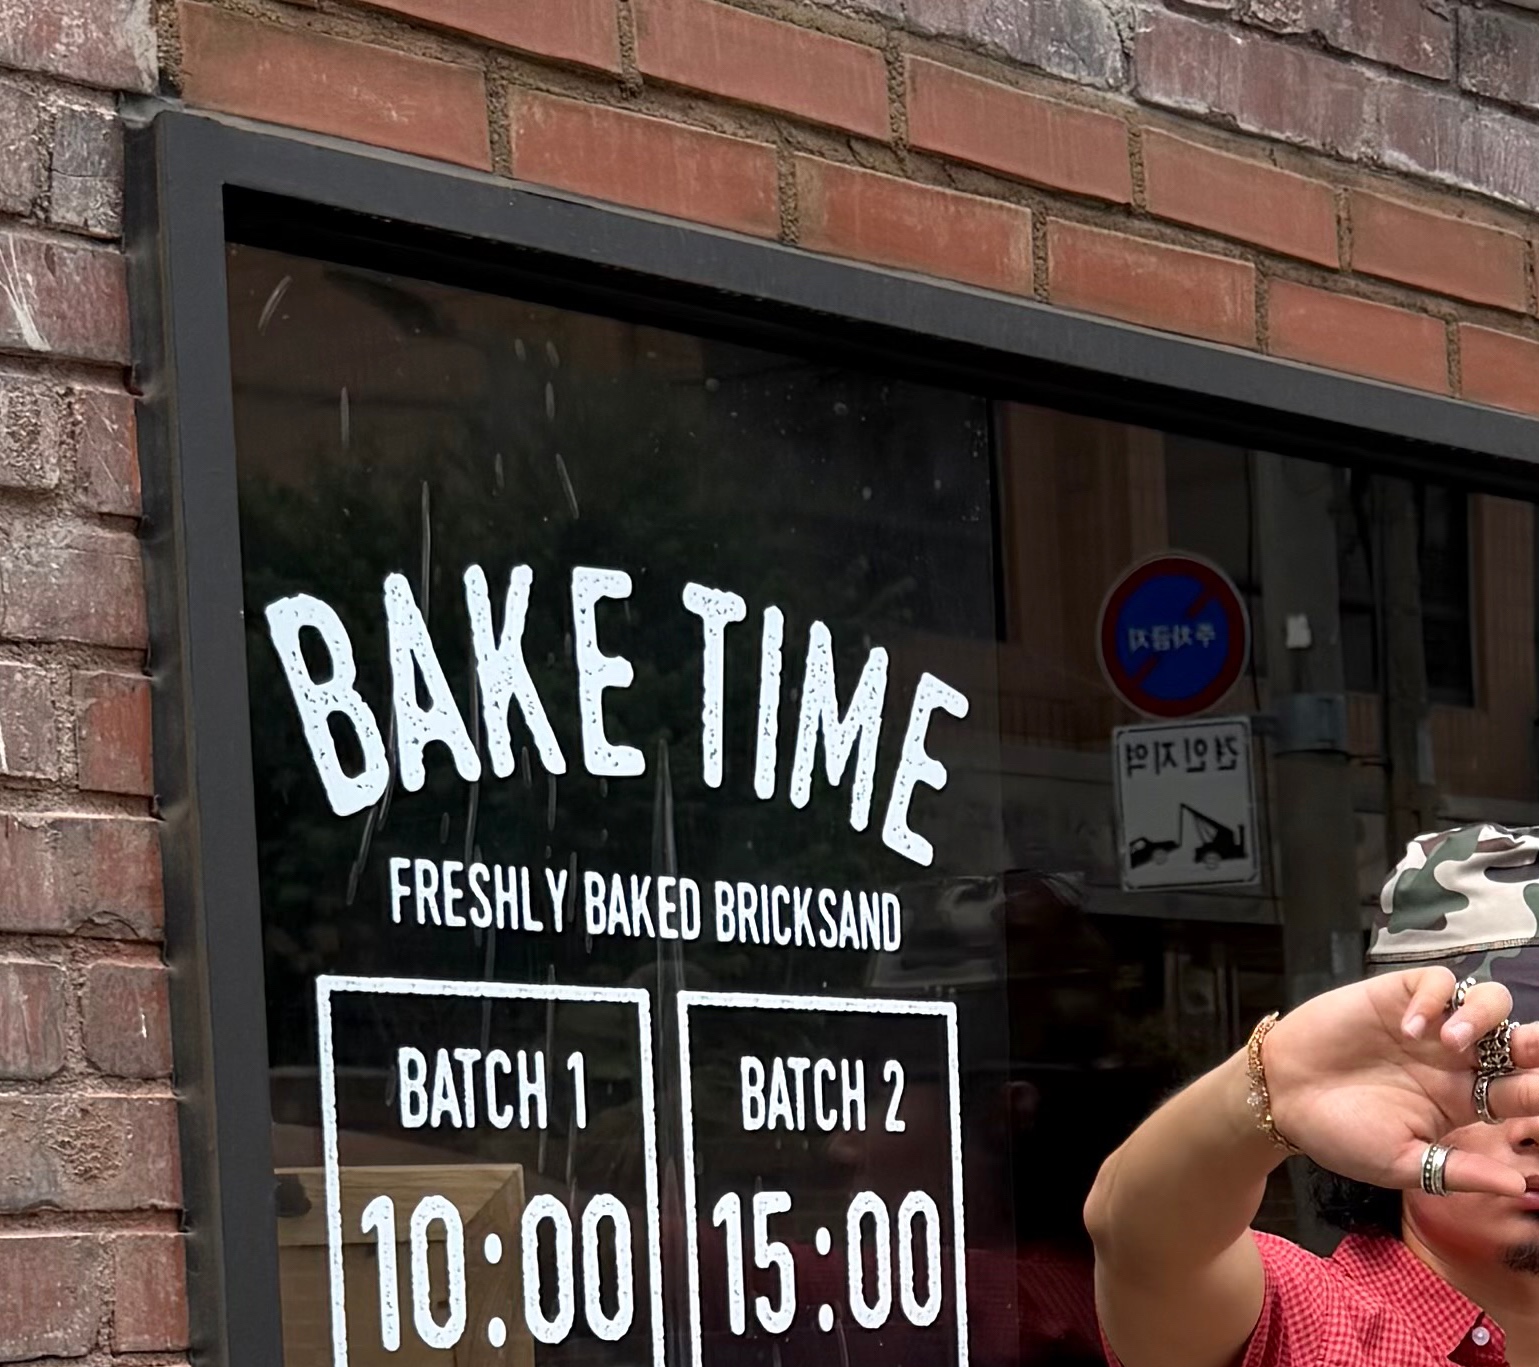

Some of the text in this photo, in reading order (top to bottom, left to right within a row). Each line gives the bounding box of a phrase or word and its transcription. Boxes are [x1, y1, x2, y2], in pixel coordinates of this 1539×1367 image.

[265, 563, 970, 867] BAKE TIME
[390, 856, 902, 952] FRESHLY BAKED BRICKSAND
[399, 1046, 587, 1130] BATCH 1
[741, 1055, 906, 1133] BATCH 2
[361, 1193, 634, 1352] 10:00
[712, 1190, 943, 1336] 15:00
